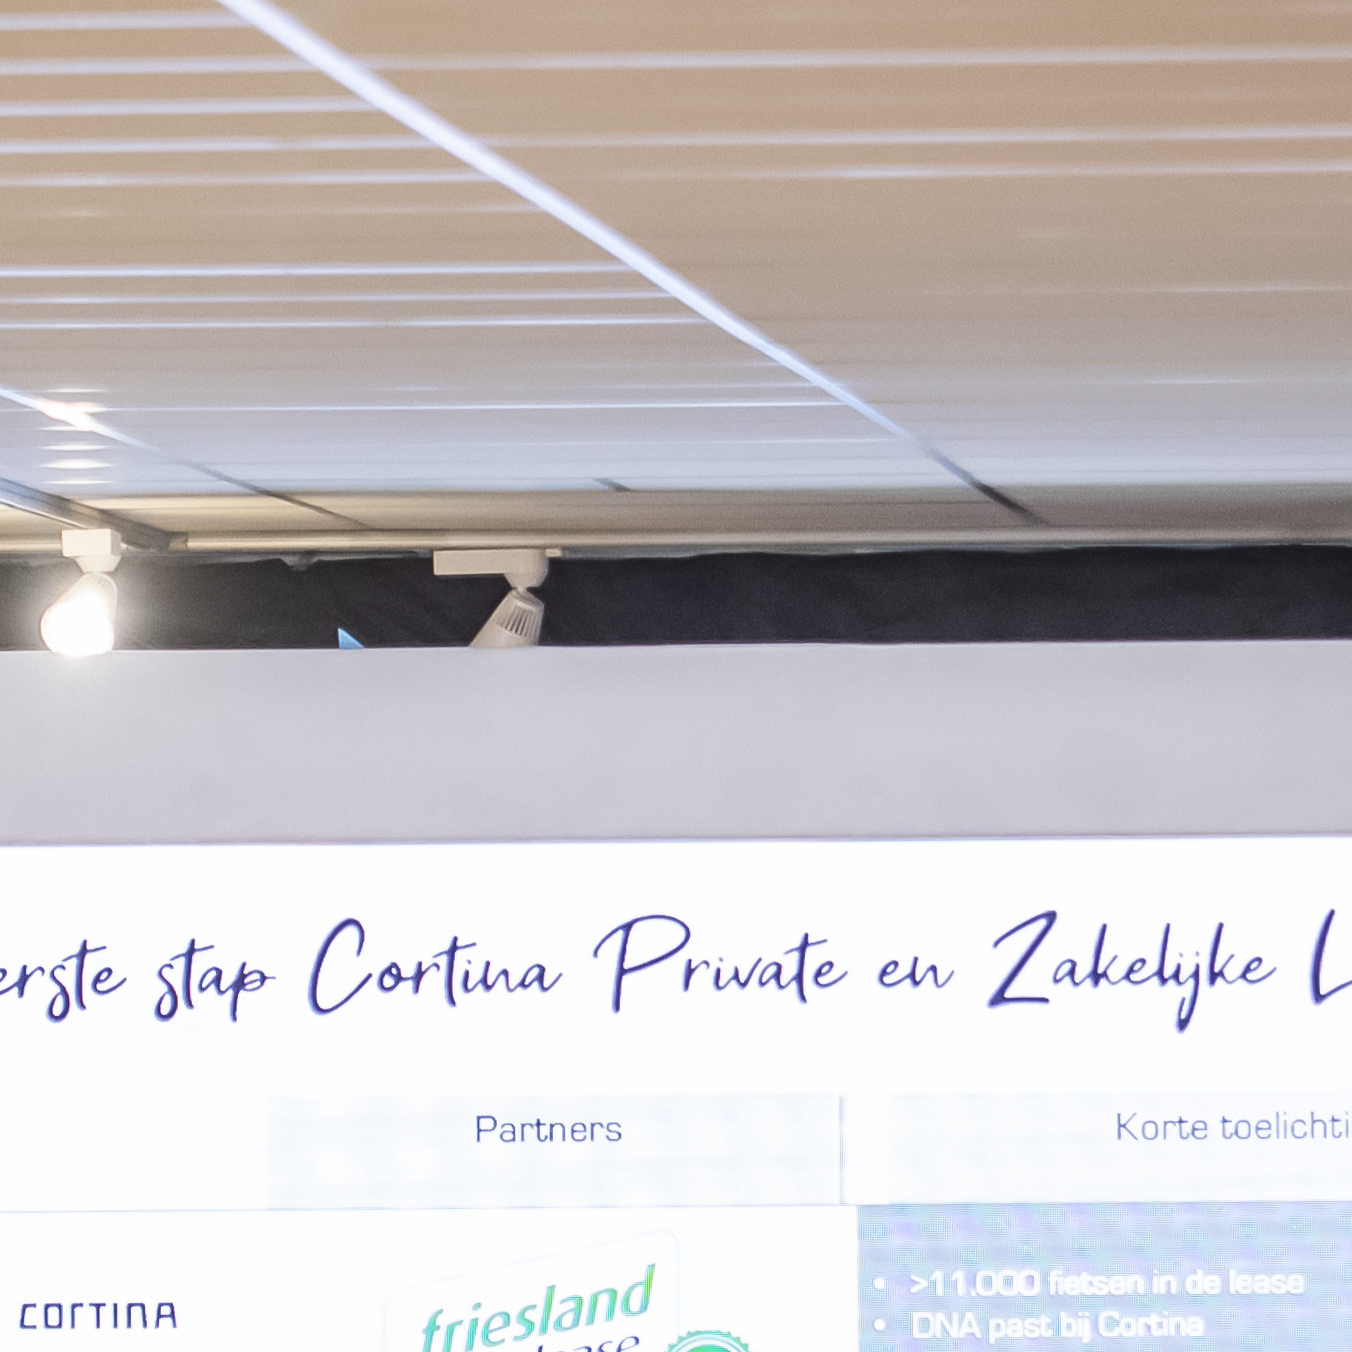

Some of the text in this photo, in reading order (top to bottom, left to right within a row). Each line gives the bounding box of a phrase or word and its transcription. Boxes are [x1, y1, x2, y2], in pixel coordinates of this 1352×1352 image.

[155, 939, 275, 1022] stap
[309, 918, 562, 1015] Cortina
[593, 915, 847, 1013] Private
[878, 953, 955, 989] en
[988, 911, 1276, 1032] Zakelijke
[477, 1116, 621, 1142] Partners
[1117, 1113, 1207, 1140] Korte
[1048, 1269, 1146, 1295] fietsen
[1152, 1270, 1177, 1295] in
[1186, 1269, 1221, 1294] de
[1229, 1268, 1305, 1294] lease
[20, 1303, 176, 1329] CORTINA
[913, 1311, 1205, 1344] DNA past bij Cortina
